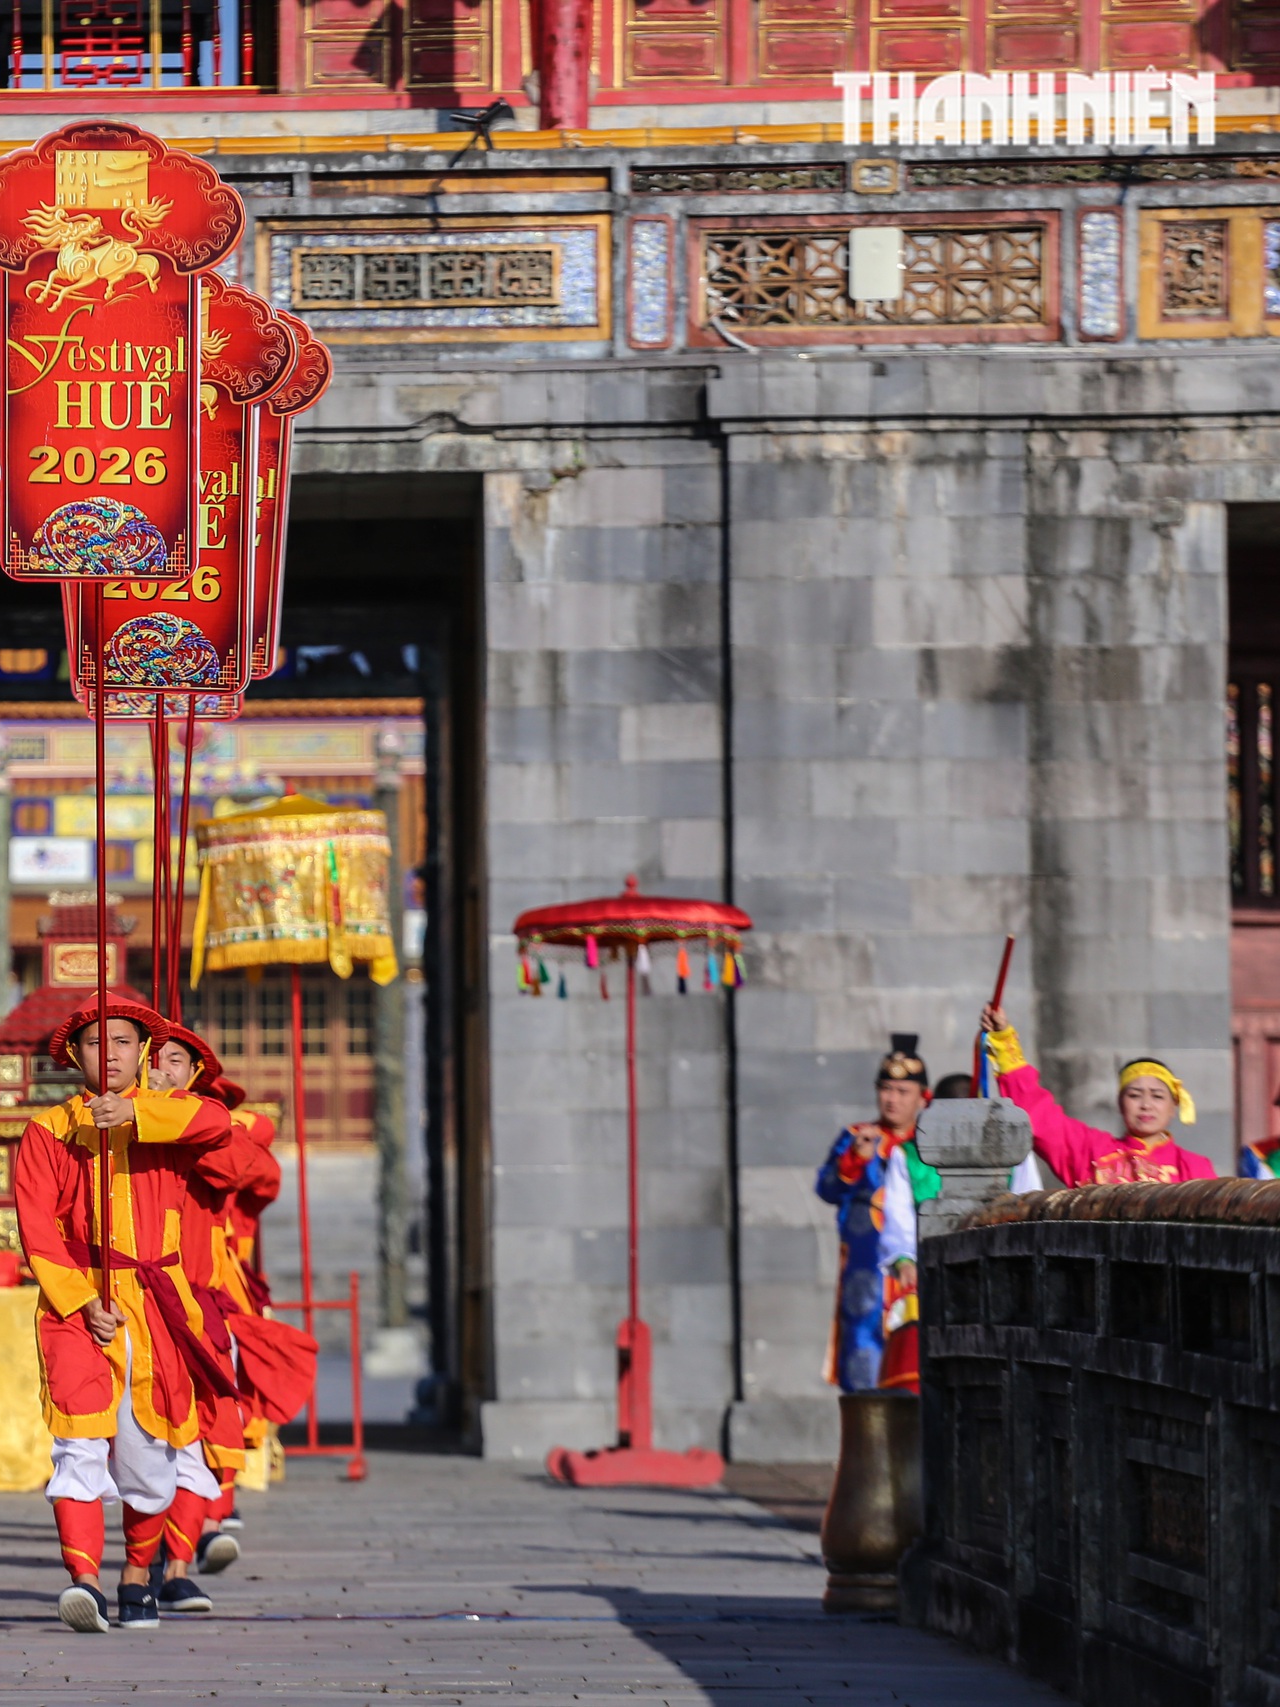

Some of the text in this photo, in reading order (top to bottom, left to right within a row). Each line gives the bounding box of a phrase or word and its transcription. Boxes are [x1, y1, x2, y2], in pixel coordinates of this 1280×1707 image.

[58, 152, 99, 164] FEST
[7, 304, 186, 395] Festival
[53, 371, 172, 430] HUẾ
[28, 446, 168, 485] 2026
